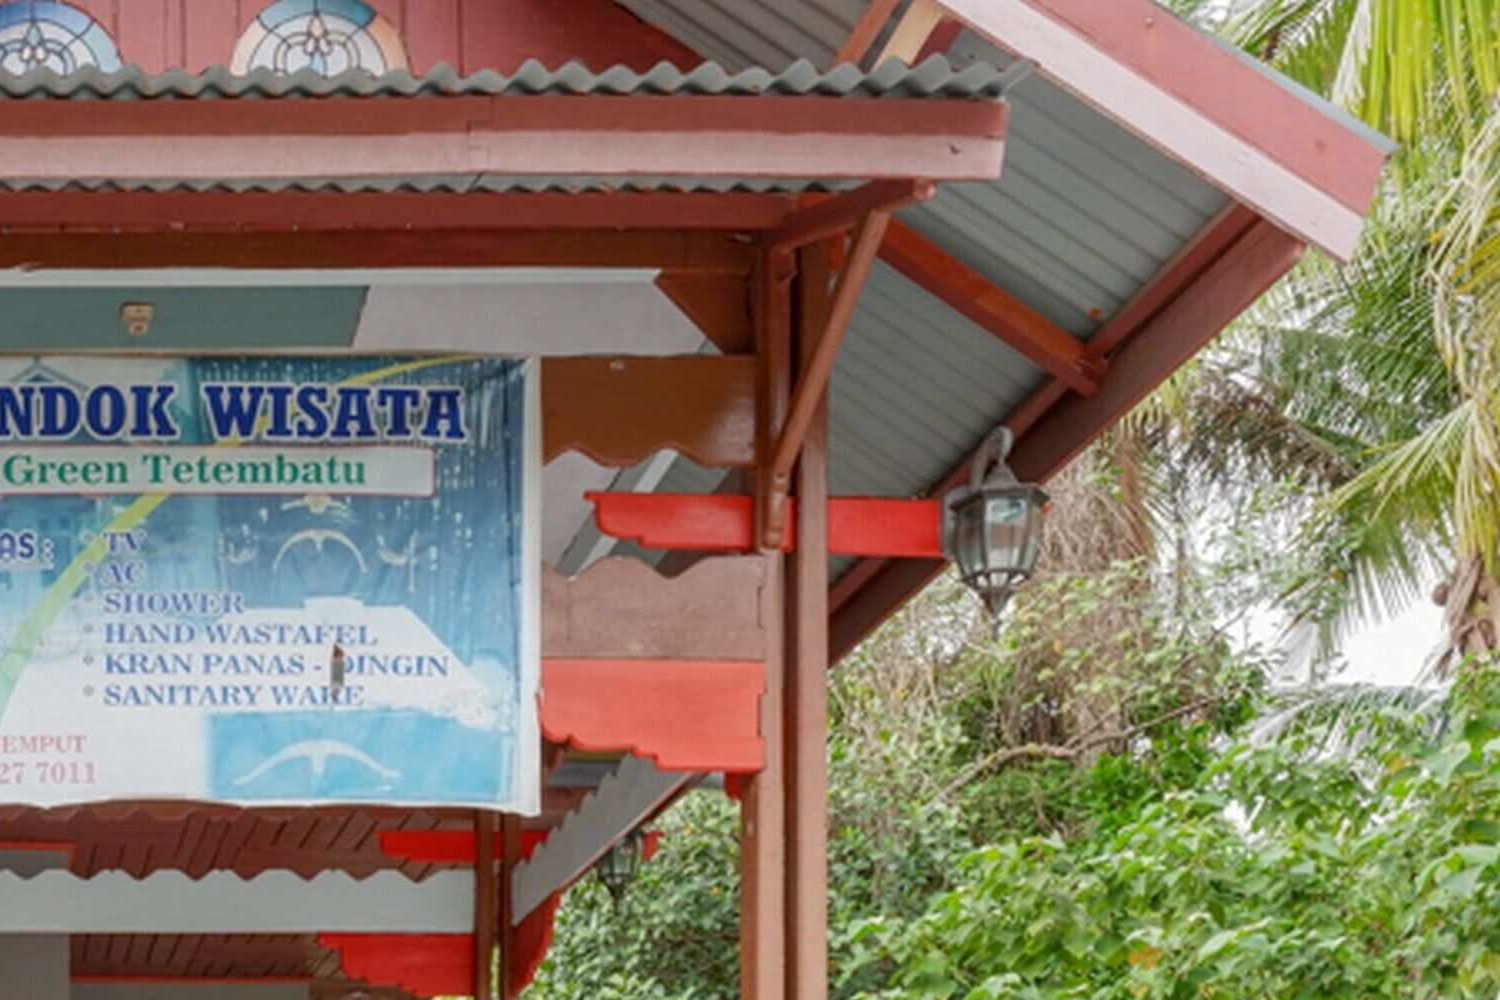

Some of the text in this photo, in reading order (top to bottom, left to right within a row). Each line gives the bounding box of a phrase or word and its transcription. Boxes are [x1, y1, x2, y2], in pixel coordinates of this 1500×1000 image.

[203, 385, 466, 439] WISATA
[3, 453, 367, 486] Green Tetembatu
[103, 532, 146, 551] TV
[103, 564, 144, 583] AC
[103, 592, 244, 614] SHOWER
[104, 622, 378, 645] HAND WASTAFEL
[104, 653, 193, 674] KRAN
[202, 654, 305, 675] PANAS
[103, 684, 365, 706] SANITARY WARE
[36, 762, 96, 783] 7011
